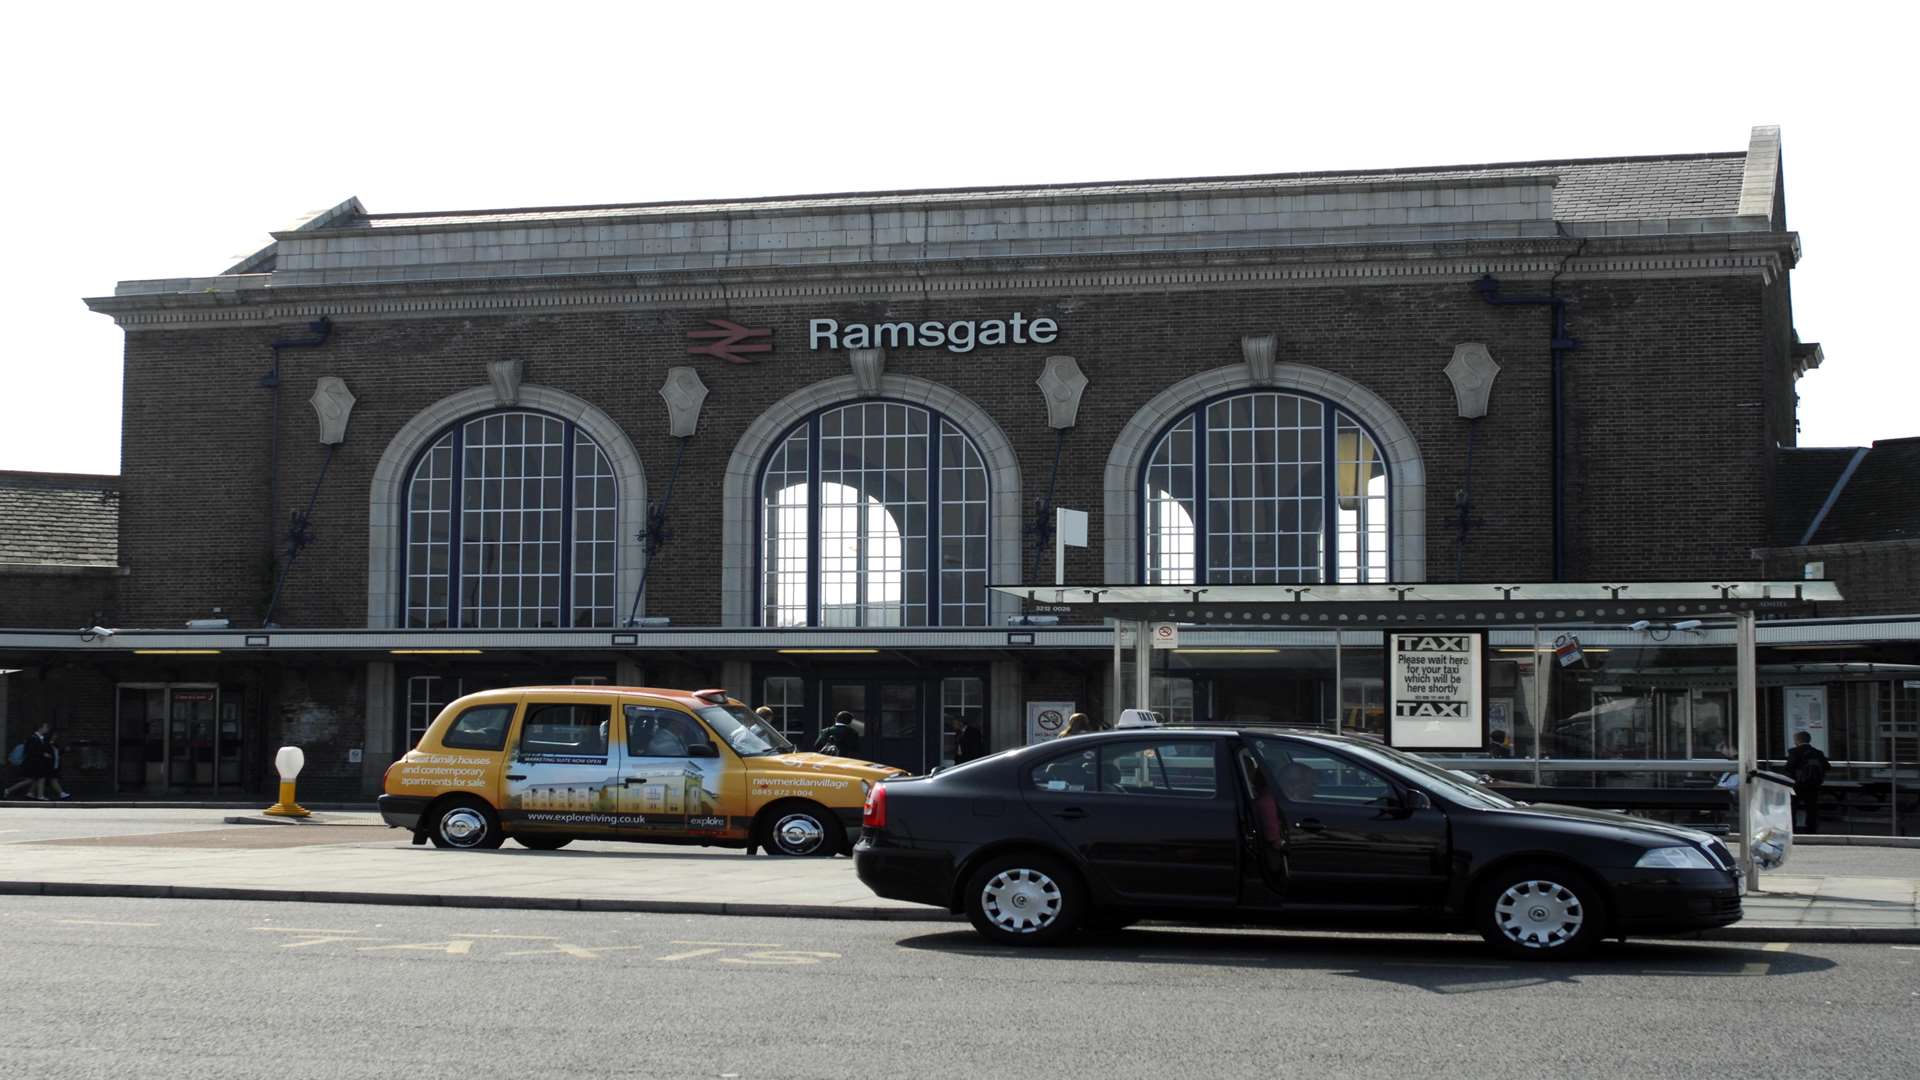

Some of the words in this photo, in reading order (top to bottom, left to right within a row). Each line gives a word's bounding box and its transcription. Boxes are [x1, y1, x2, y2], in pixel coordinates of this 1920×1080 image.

[809, 312, 1058, 352] Ramsgate
[1398, 637, 1469, 651] TAXI
[1398, 654, 1426, 664] Please
[1428, 655, 1447, 664] wait
[1449, 655, 1469, 664] here
[1407, 664, 1420, 674] for
[1422, 666, 1441, 675] your
[1443, 664, 1459, 673] taxi
[1405, 674, 1431, 683] which
[1433, 674, 1448, 683] will
[1450, 674, 1462, 683] be
[1407, 683, 1426, 693] here
[1428, 684, 1459, 695] shortly
[1397, 702, 1468, 717] TAXI
[1137, 711, 1155, 721] TAXI
[458, 756, 490, 764] houses
[402, 766, 420, 774] and
[421, 767, 485, 776] contemporary
[402, 777, 452, 786] apartments
[453, 776, 468, 786] for
[469, 778, 487, 787] sale
[527, 813, 646, 825] www.exploreliving.co.uk
[690, 817, 724, 827] explore
[248, 926, 844, 966] TAXIS
